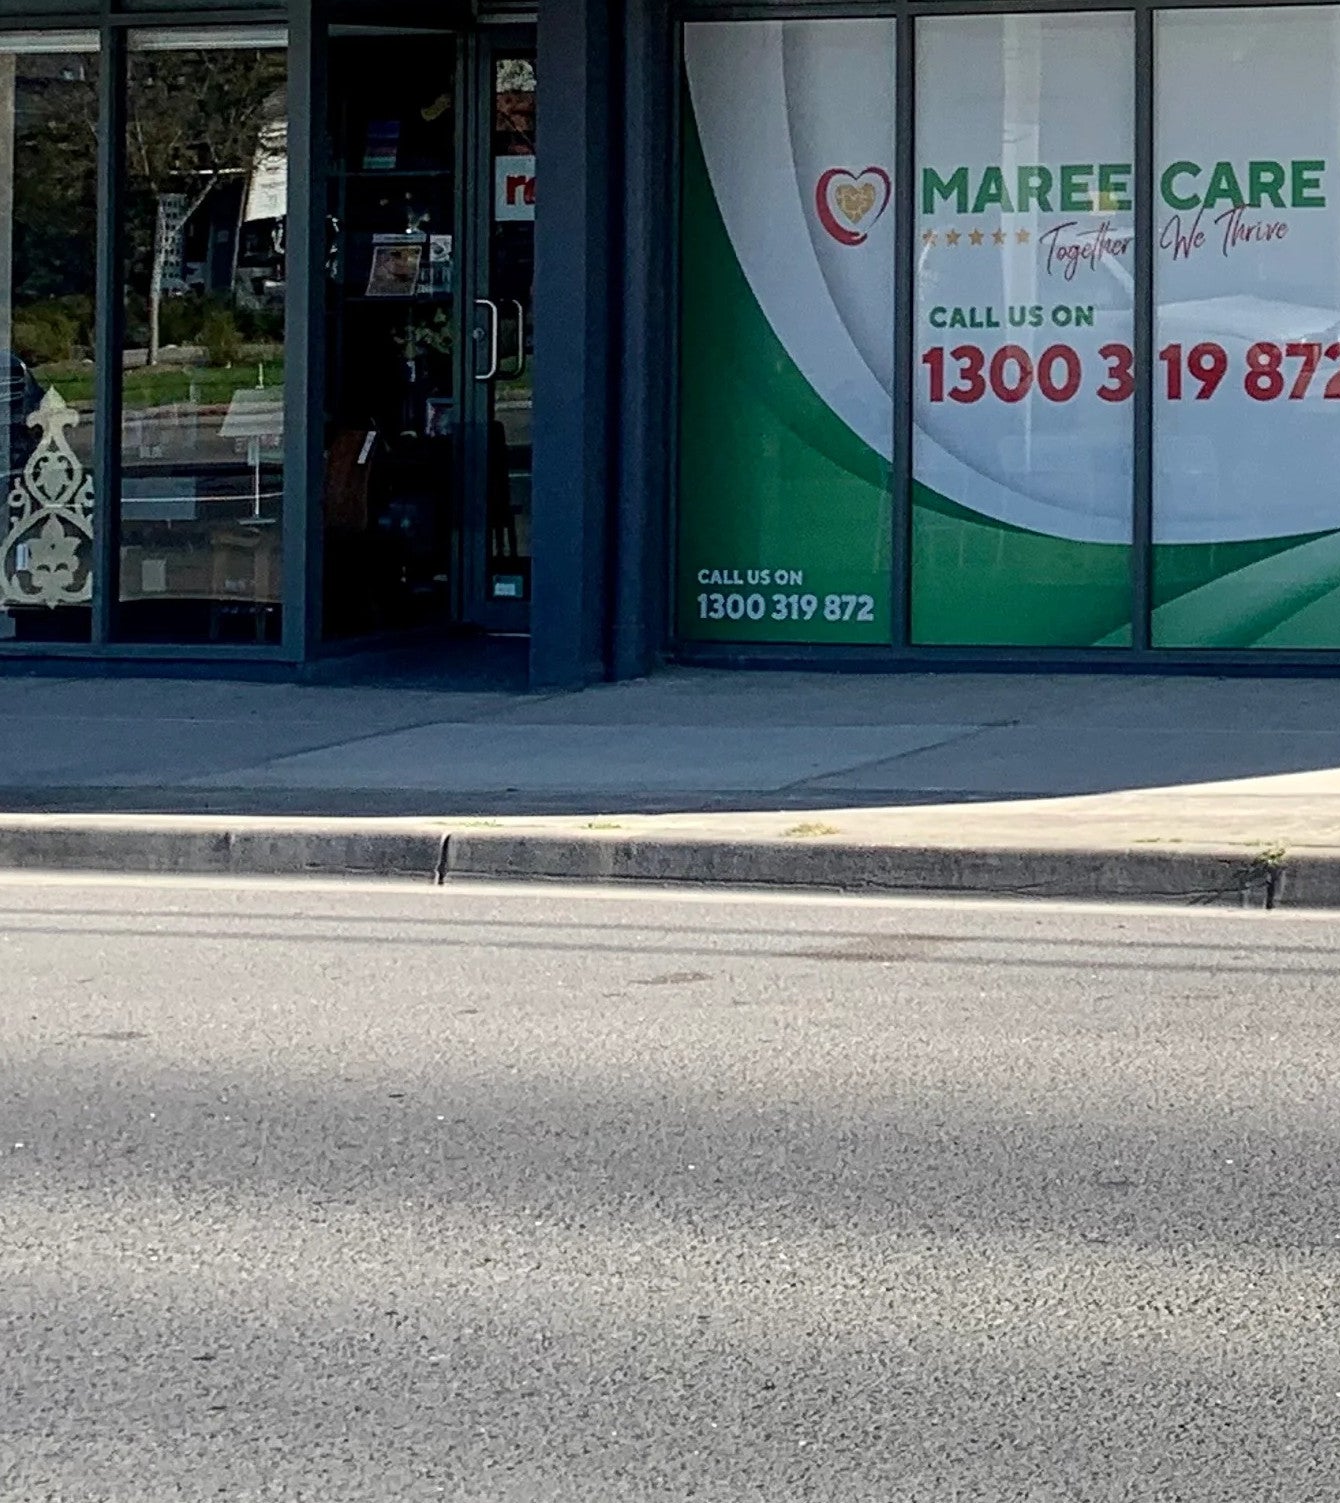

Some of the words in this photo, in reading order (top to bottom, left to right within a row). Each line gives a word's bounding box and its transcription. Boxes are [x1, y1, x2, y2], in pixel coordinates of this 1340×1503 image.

[922, 164, 1133, 214] MAREE
[1160, 160, 1326, 210] CARE
[1040, 221, 1134, 281] Together
[1160, 208, 1205, 261] We
[1214, 203, 1288, 257] Thrive
[929, 306, 999, 328] CALL
[1008, 305, 1043, 327] US
[1052, 304, 1094, 327] ON
[922, 344, 1082, 402] 1300
[698, 569, 744, 585] CALL
[747, 570, 771, 585] US
[774, 570, 803, 586] ON
[697, 593, 766, 620] 1300
[771, 594, 818, 621] 319
[823, 594, 874, 622] 872
